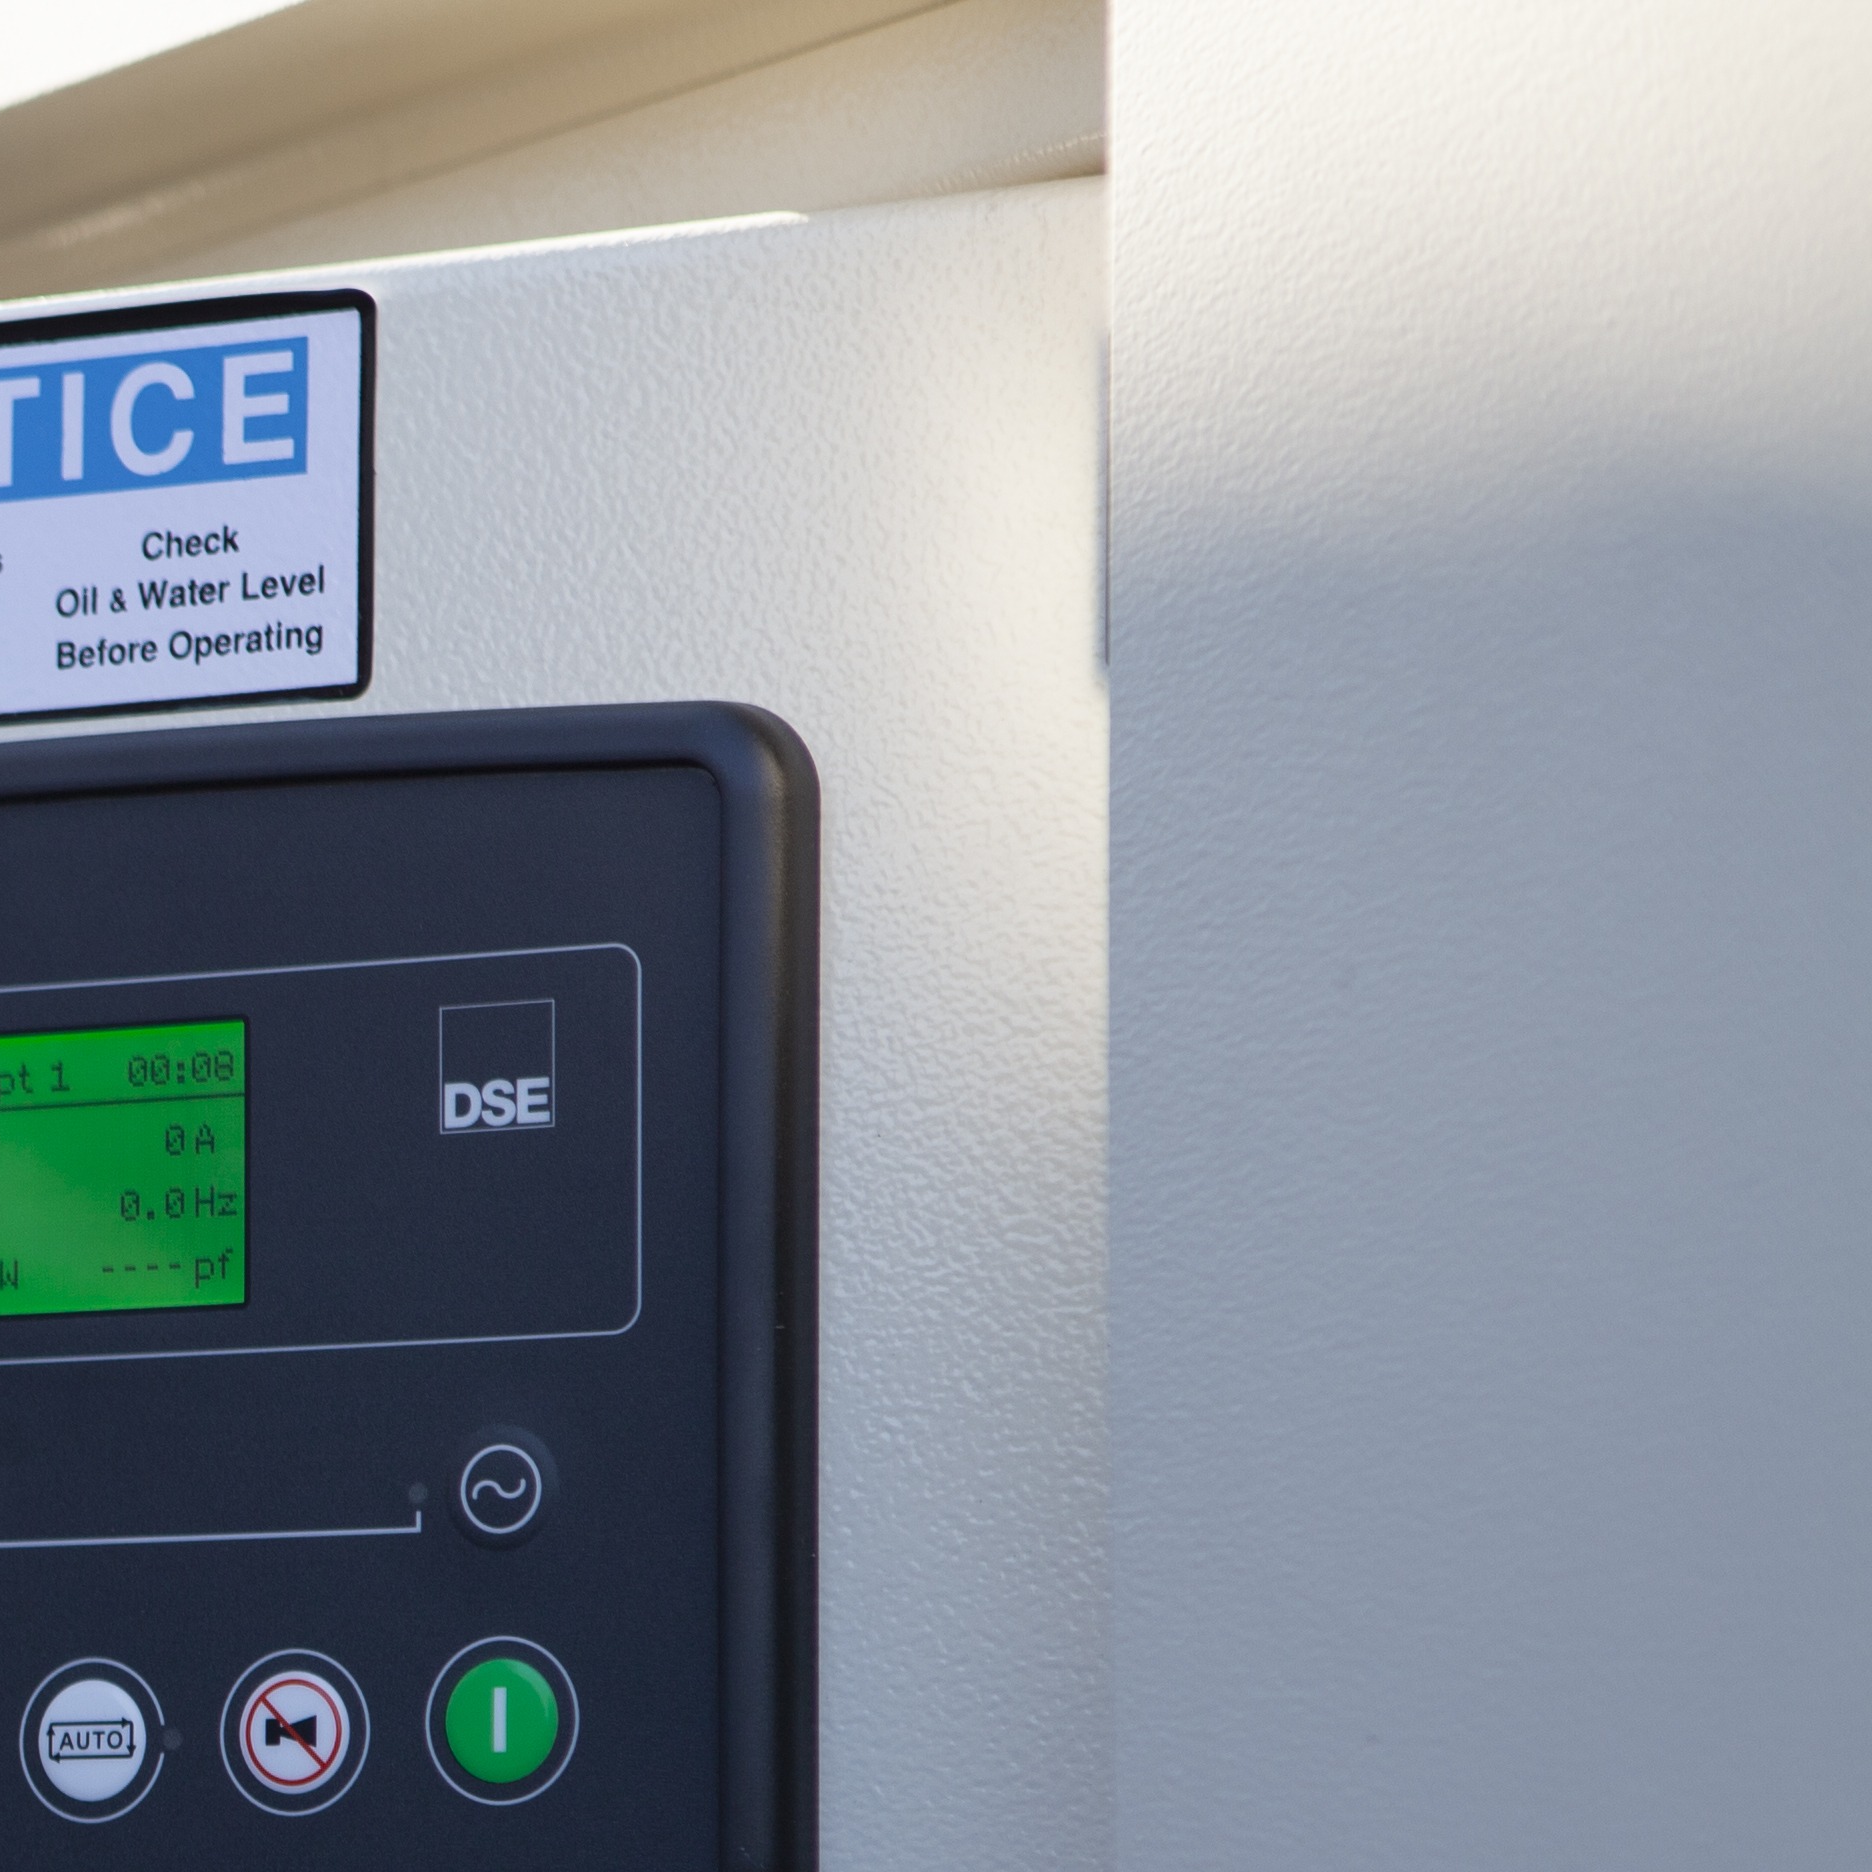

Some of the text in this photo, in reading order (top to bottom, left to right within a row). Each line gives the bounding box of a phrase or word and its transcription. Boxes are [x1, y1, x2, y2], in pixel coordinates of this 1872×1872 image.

[142, 525, 239, 561] Check
[55, 565, 326, 619] Oil & Water Level
[56, 621, 325, 670] Before Operating
[51, 1060, 70, 1092] 1
[127, 1050, 235, 1088] 00:08
[444, 1077, 550, 1129] DSE
[59, 1730, 123, 1751] AUTO
